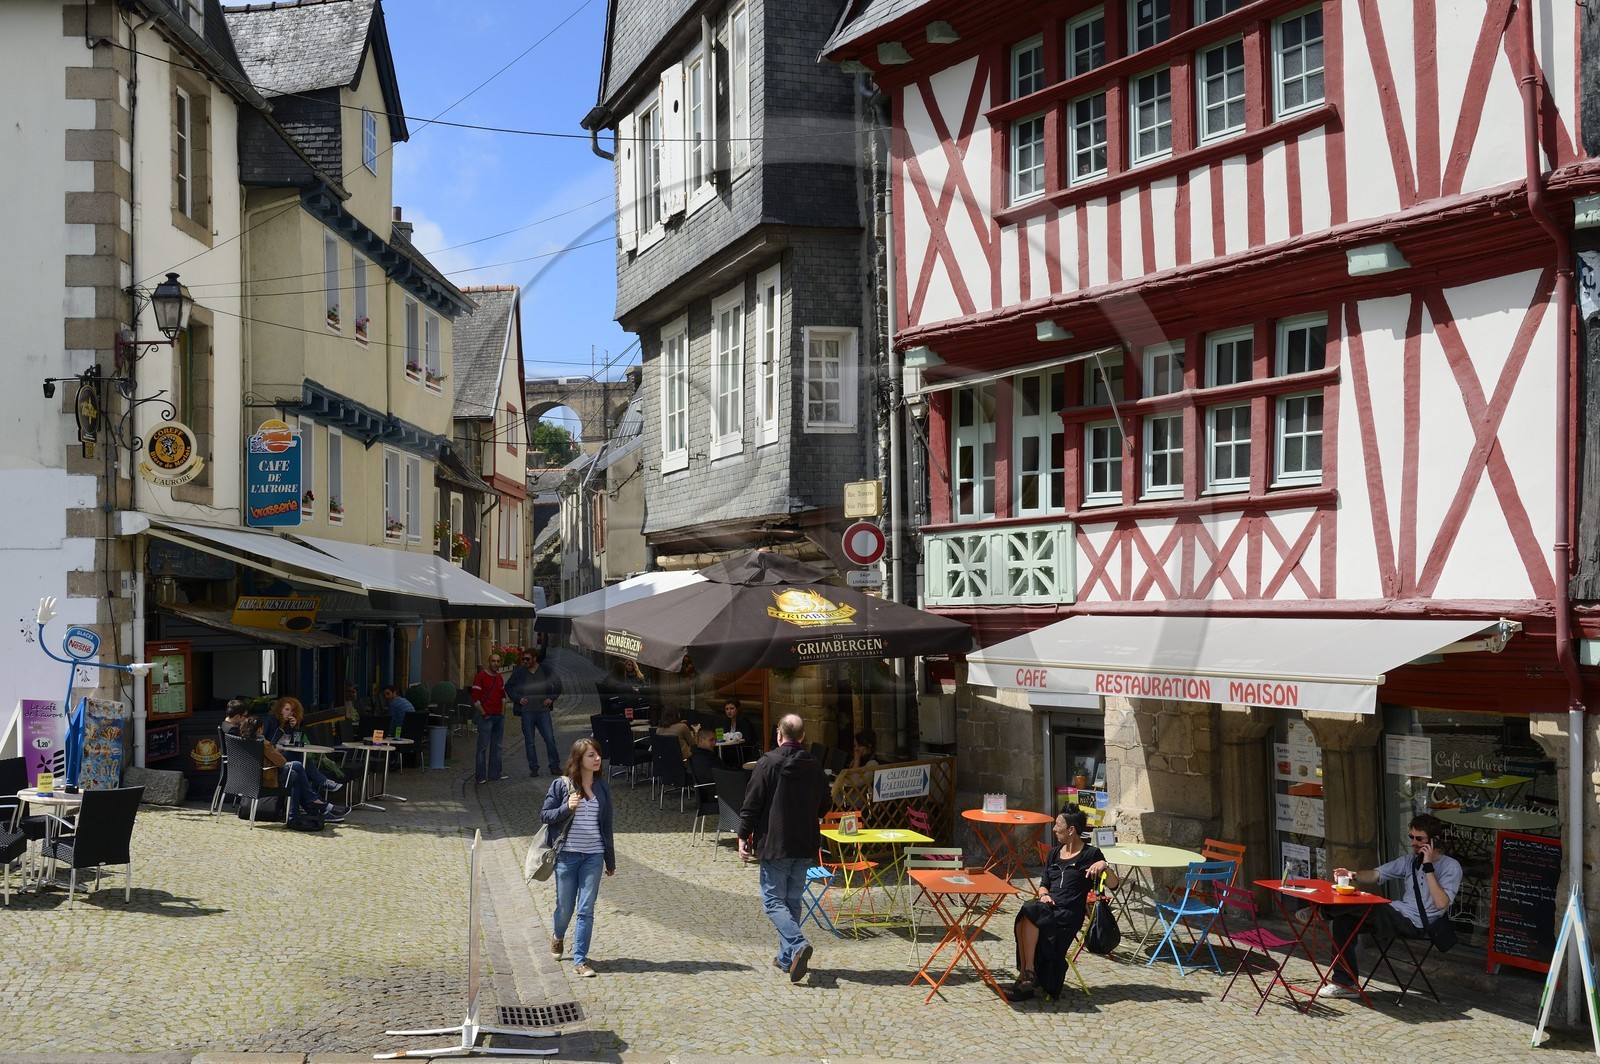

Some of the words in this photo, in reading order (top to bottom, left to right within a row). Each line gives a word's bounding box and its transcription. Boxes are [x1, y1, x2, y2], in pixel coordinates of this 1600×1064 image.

[153, 427, 184, 440] COREFF
[174, 446, 191, 466] Morlaix
[258, 460, 290, 471] CAFE
[153, 473, 193, 485] L'AURORE
[267, 473, 282, 482] DE
[250, 484, 299, 493] L'AURORE
[250, 499, 298, 519] brasserie
[238, 599, 257, 610] BAR
[256, 599, 264, 610] &
[264, 600, 318, 611] RESTAURATION
[776, 607, 853, 619] GRIMBERGEN
[76, 630, 94, 640] GLACES
[606, 633, 641, 652] GRIMBERGEN
[797, 638, 883, 655] GRIMBERGEN
[1016, 668, 1048, 688] CAFE
[1096, 673, 1211, 700] RESTAURATION
[1229, 681, 1298, 707] MAISON
[42, 702, 57, 712] café
[1435, 751, 1462, 773] Café
[1464, 753, 1510, 772] culturel
[1426, 782, 1481, 808] Trait
[1485, 793, 1560, 817] d'union
